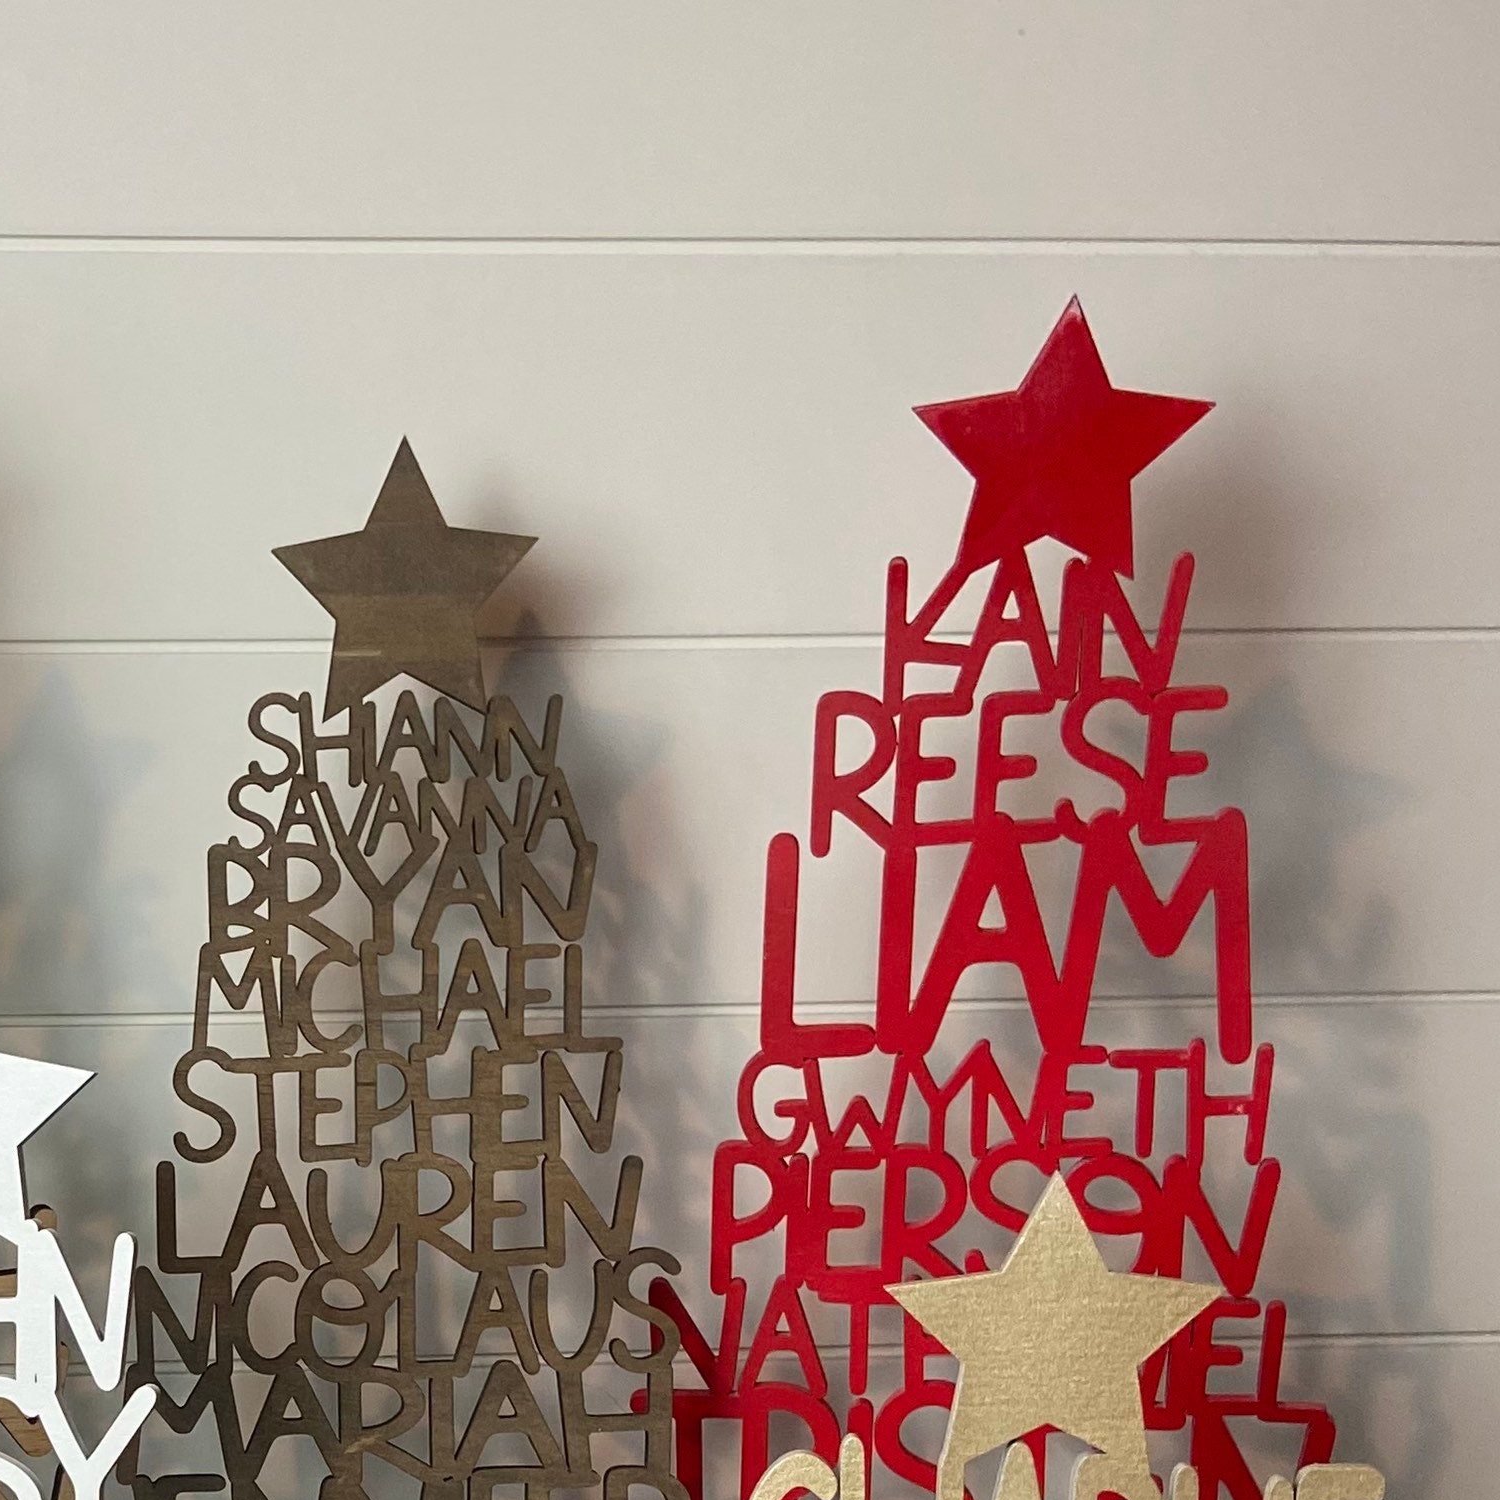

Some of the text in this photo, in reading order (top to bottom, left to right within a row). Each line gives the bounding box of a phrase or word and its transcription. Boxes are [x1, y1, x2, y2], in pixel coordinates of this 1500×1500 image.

[882, 549, 1195, 712] KAIN
[248, 690, 563, 787] SHIANN
[810, 676, 1229, 858] REESE
[228, 766, 590, 856] SAVANNA
[208, 838, 598, 957] BRYAN
[761, 807, 1252, 1064] LIAM
[192, 938, 623, 1057] MICHAEL
[173, 1045, 623, 1166] STEPHEN
[737, 1038, 1275, 1170] GWYNETH
[156, 1152, 643, 1274] LAUREN
[133, 1246, 682, 1380] NICOLAUS
[116, 1359, 675, 1485] MARIAH
